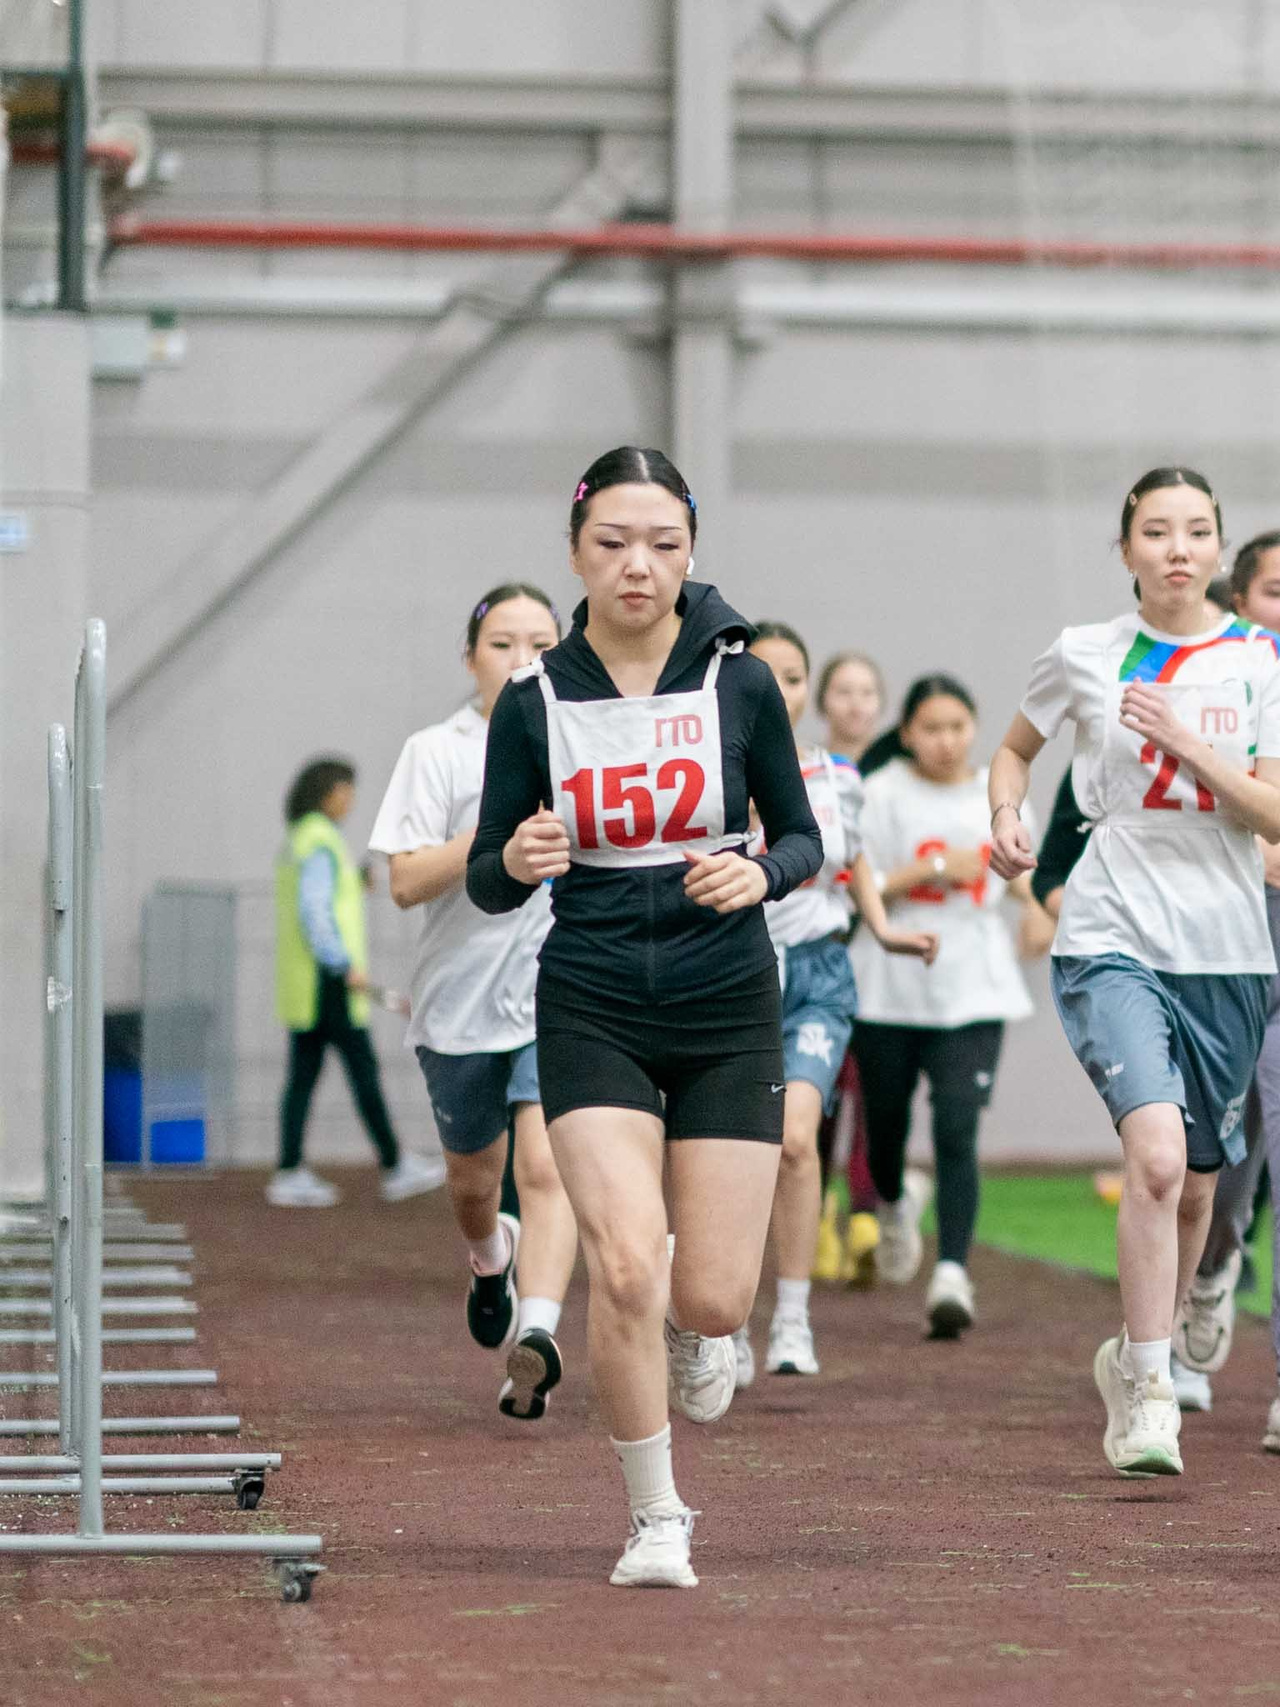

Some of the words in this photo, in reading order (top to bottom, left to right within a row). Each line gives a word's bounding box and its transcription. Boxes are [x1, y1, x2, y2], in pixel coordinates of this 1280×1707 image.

[655, 714, 704, 747] ГТО
[1201, 706, 1238, 734] ГТО
[561, 758, 708, 850] 152
